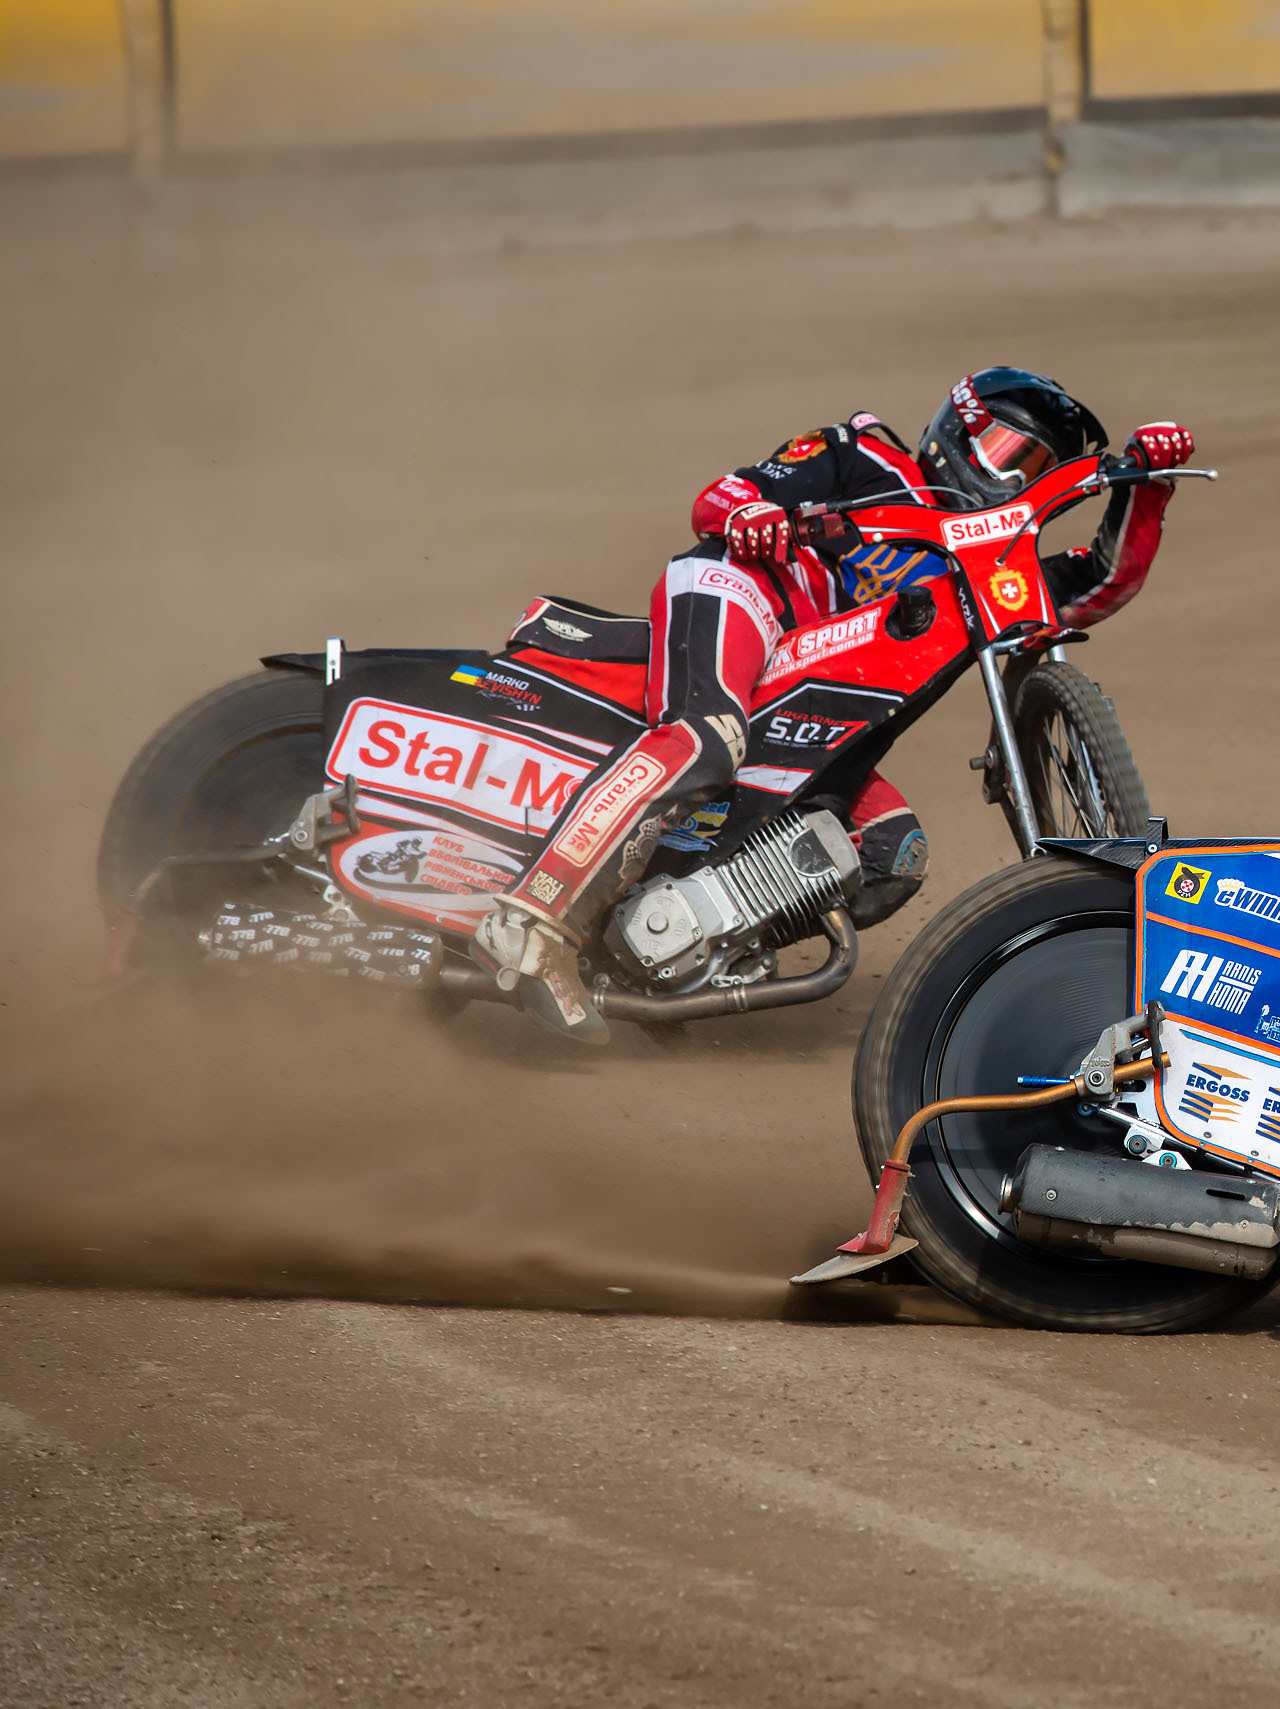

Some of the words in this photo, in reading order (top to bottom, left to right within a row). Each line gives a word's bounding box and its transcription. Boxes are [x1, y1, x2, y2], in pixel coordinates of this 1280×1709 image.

[799, 607, 881, 656] SPORT
[474, 678, 542, 705] LEVISHYN
[485, 671, 530, 691] MARKO
[358, 719, 583, 817] Stal-M
[432, 836, 465, 853] КЛУБ
[1221, 960, 1262, 985] ARNIS
[1206, 981, 1252, 1015] HOMA
[1185, 1073, 1251, 1103] ERGOSS
